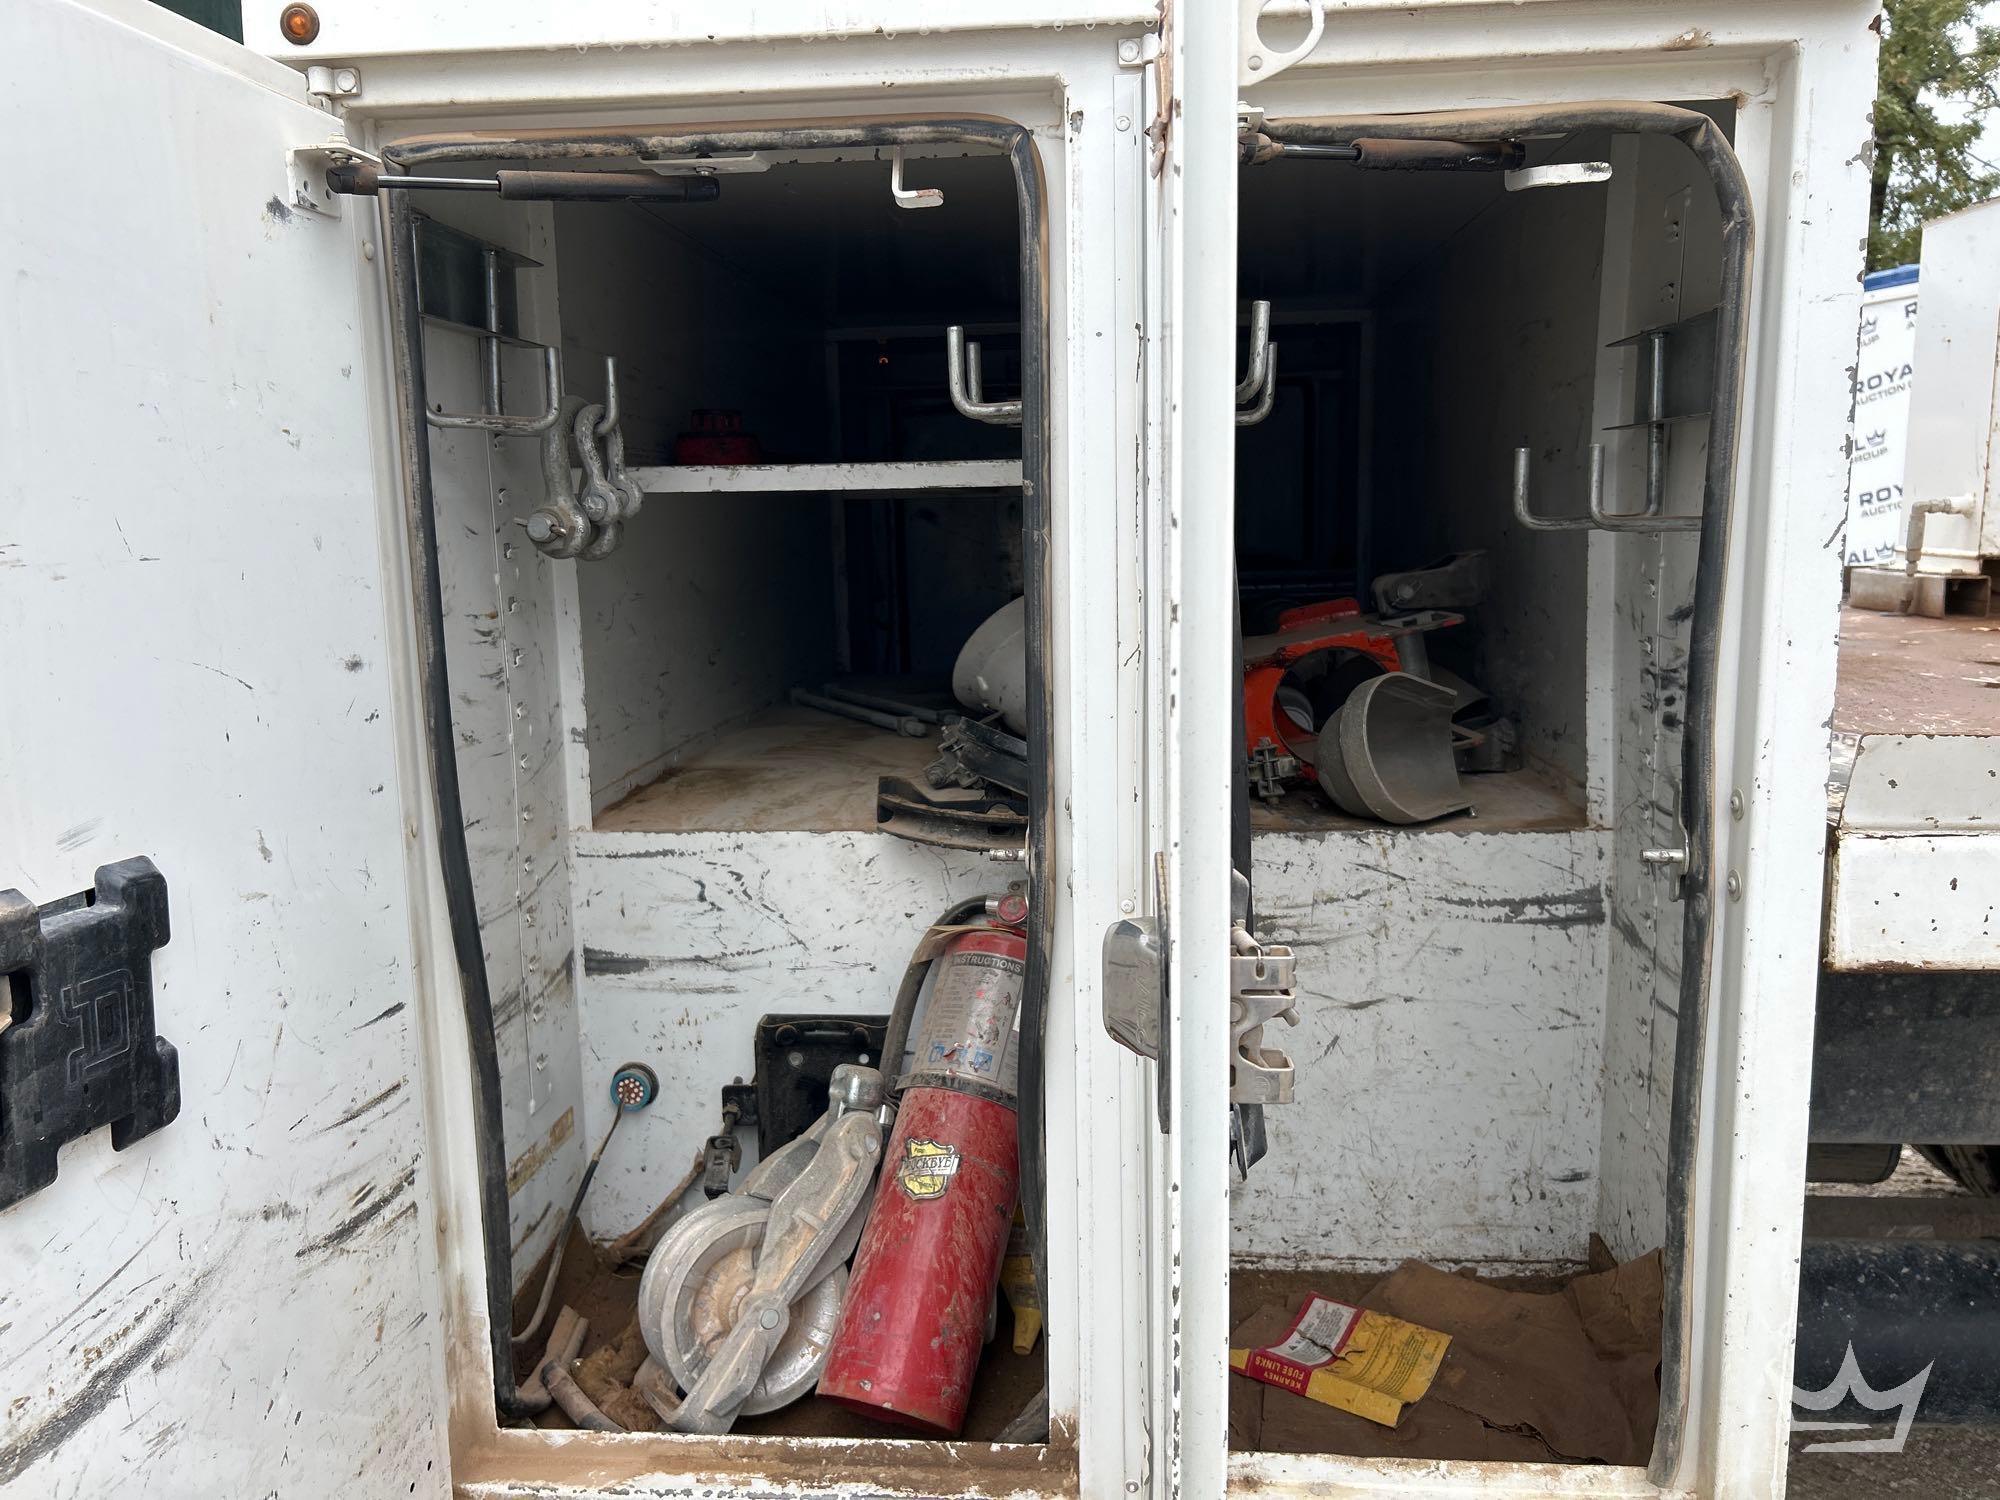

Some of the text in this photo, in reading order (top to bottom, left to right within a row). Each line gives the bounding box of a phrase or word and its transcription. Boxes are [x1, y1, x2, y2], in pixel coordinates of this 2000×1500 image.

[1254, 1355, 1305, 1381] FUSE LINKS
[1263, 1370, 1302, 1390] KEARNEY
